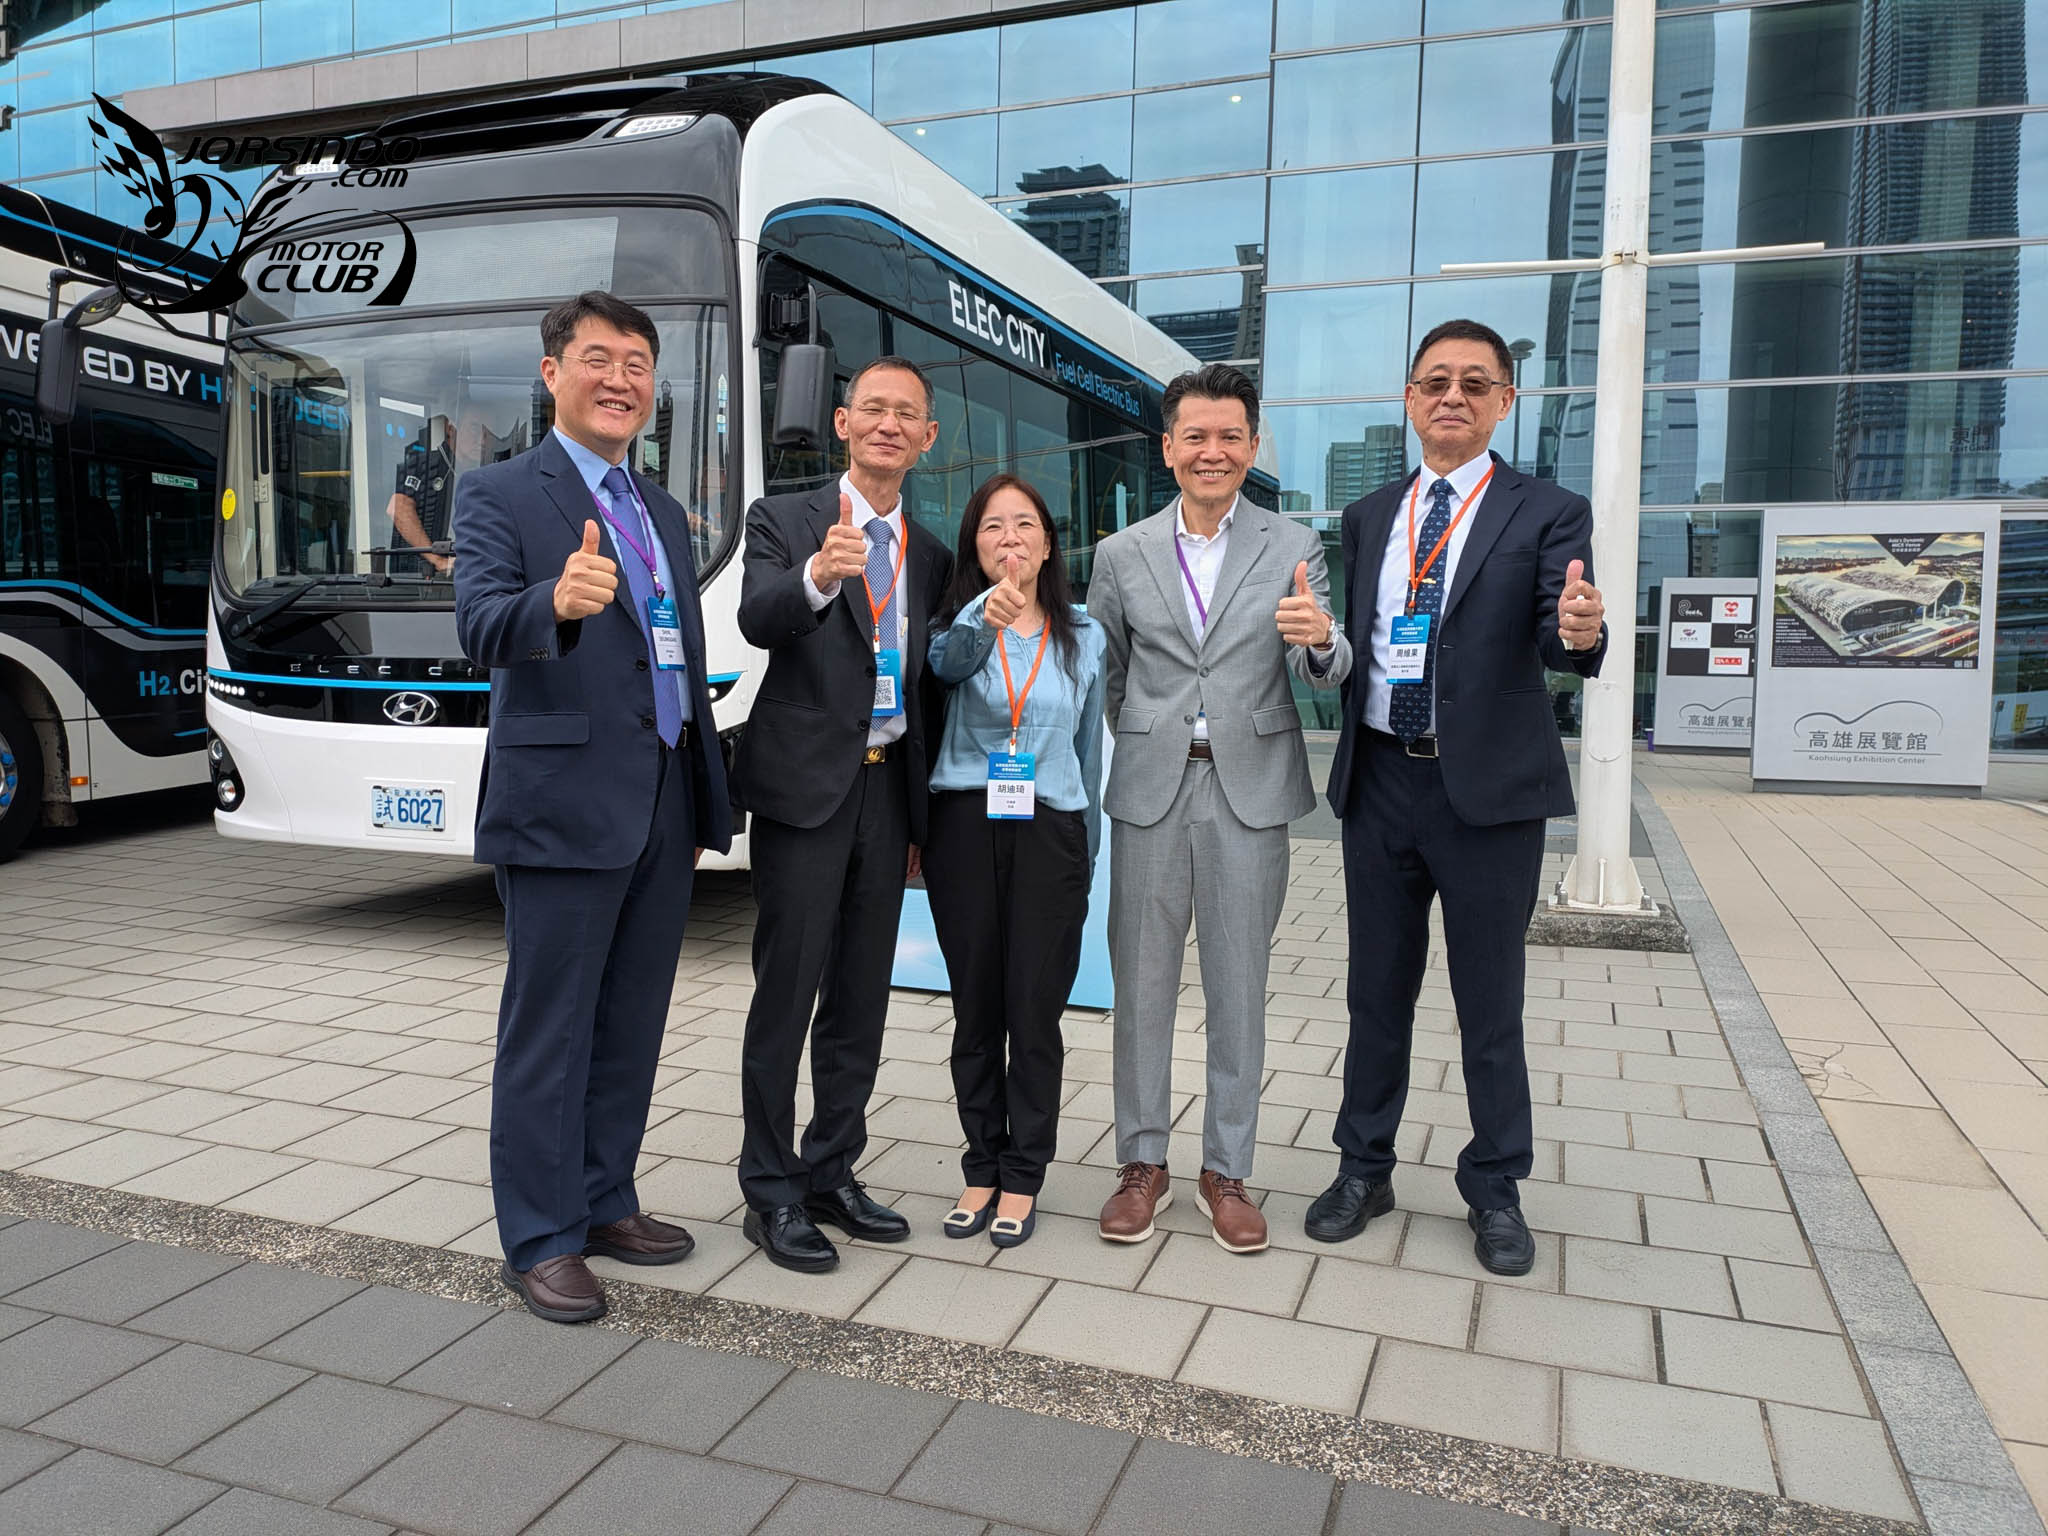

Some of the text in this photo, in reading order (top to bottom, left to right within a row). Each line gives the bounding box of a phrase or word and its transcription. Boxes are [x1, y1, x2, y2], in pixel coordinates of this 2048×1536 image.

[949, 280, 1045, 368] ELEC CITY
[144, 360, 191, 395] BY
[1055, 352, 1140, 416] Fuel Cell Electric Bus
[290, 663, 391, 675] ELEC
[1808, 730, 1928, 751] 高雄展覽館
[1808, 754, 1852, 763] Kaohsiung
